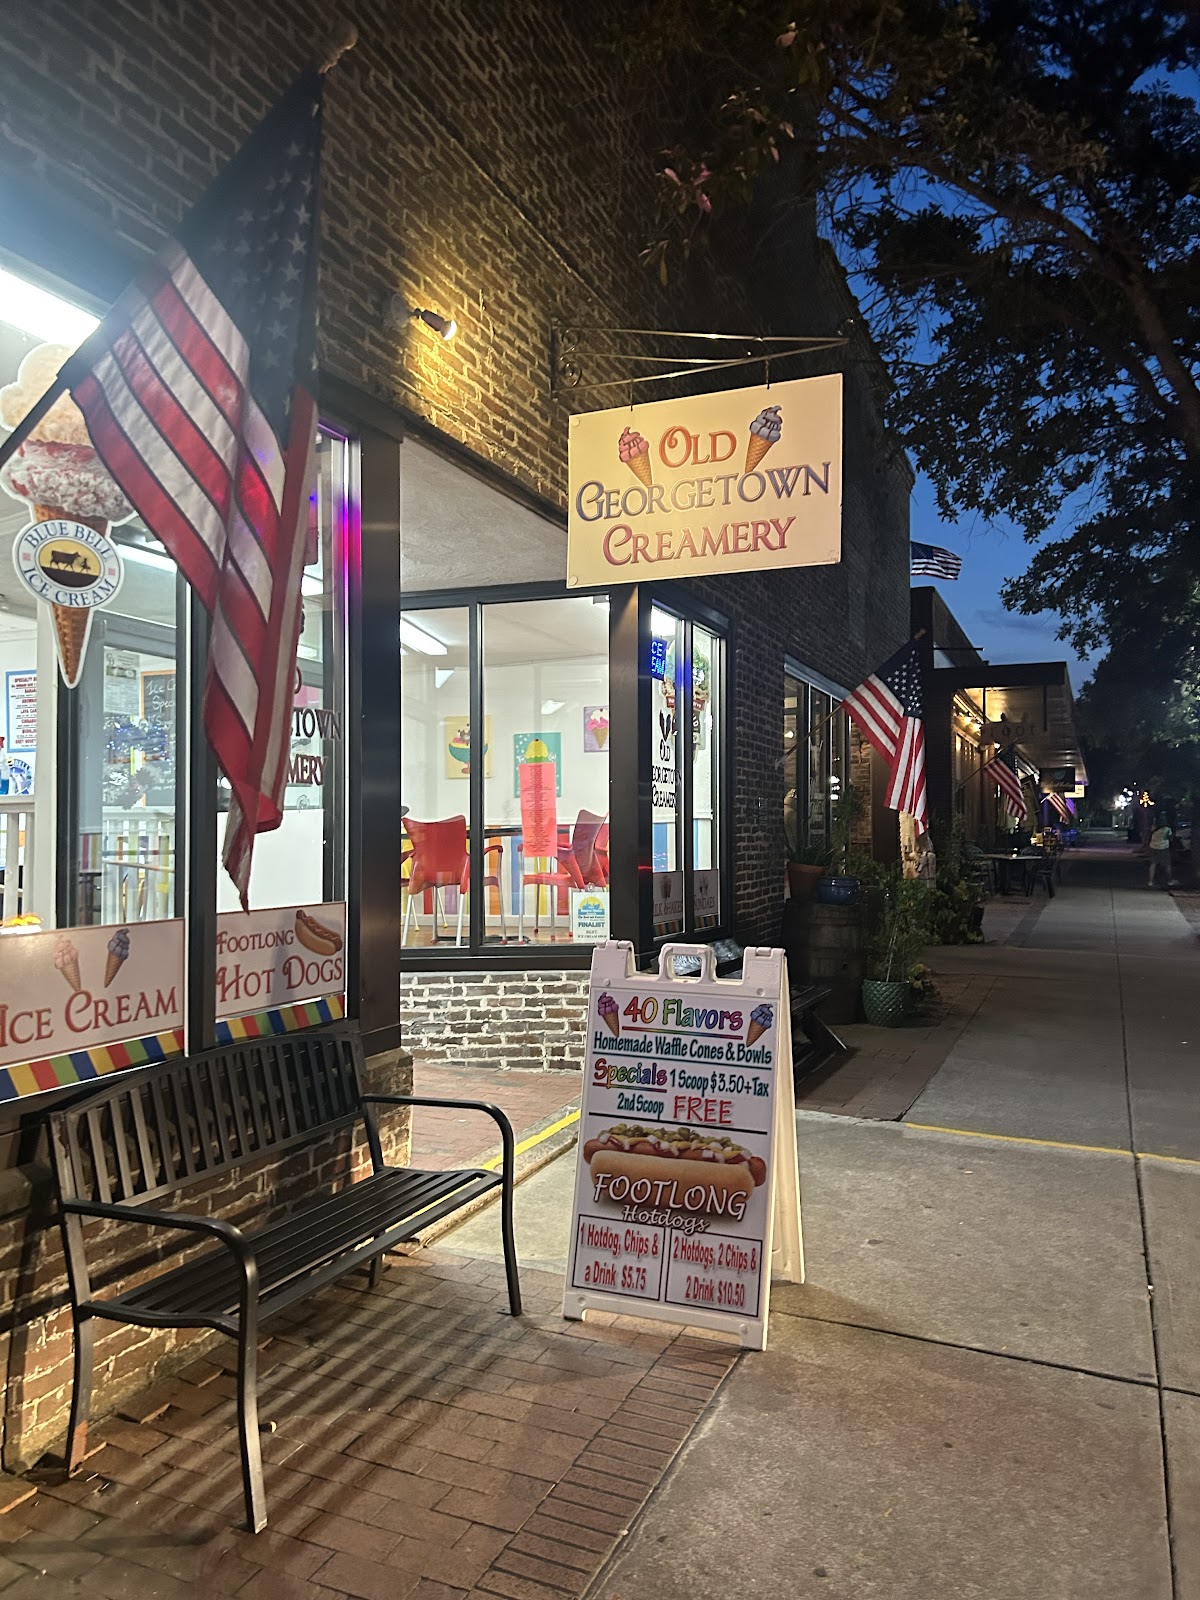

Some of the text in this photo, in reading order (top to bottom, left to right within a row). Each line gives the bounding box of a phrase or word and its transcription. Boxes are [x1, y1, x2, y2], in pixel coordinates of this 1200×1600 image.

[659, 426, 736, 468] OLD
[576, 462, 831, 521] GEORGETOWN
[23, 521, 110, 560] BLUE BELL
[603, 516, 796, 566] CREAMERY
[24, 567, 115, 607] ICE CREAM
[660, 739, 671, 761] OLD
[216, 928, 294, 955] FOOTLONG
[216, 954, 343, 1002] HOT DOGS
[0, 986, 179, 1047] ICE CREAM
[623, 996, 744, 1031] 40 Flavors
[594, 1031, 772, 1065] Homemade Waffle Cones & Bowls
[594, 1058, 668, 1089] Specials
[670, 1068, 676, 1087] 1
[678, 1069, 709, 1097] Scoop
[617, 1092, 733, 1124] 2nd Scoop FREE
[593, 1172, 748, 1222] FOOTLONG
[622, 1205, 710, 1235] Hotdogs
[580, 1222, 659, 1259] 1 Hotdog, Chips &
[673, 1236, 757, 1274] 2 Hotdogs, 2 Chips &
[584, 1261, 647, 1291] a Drink $5.75
[685, 1275, 746, 1307] 2 Drink $10.50
